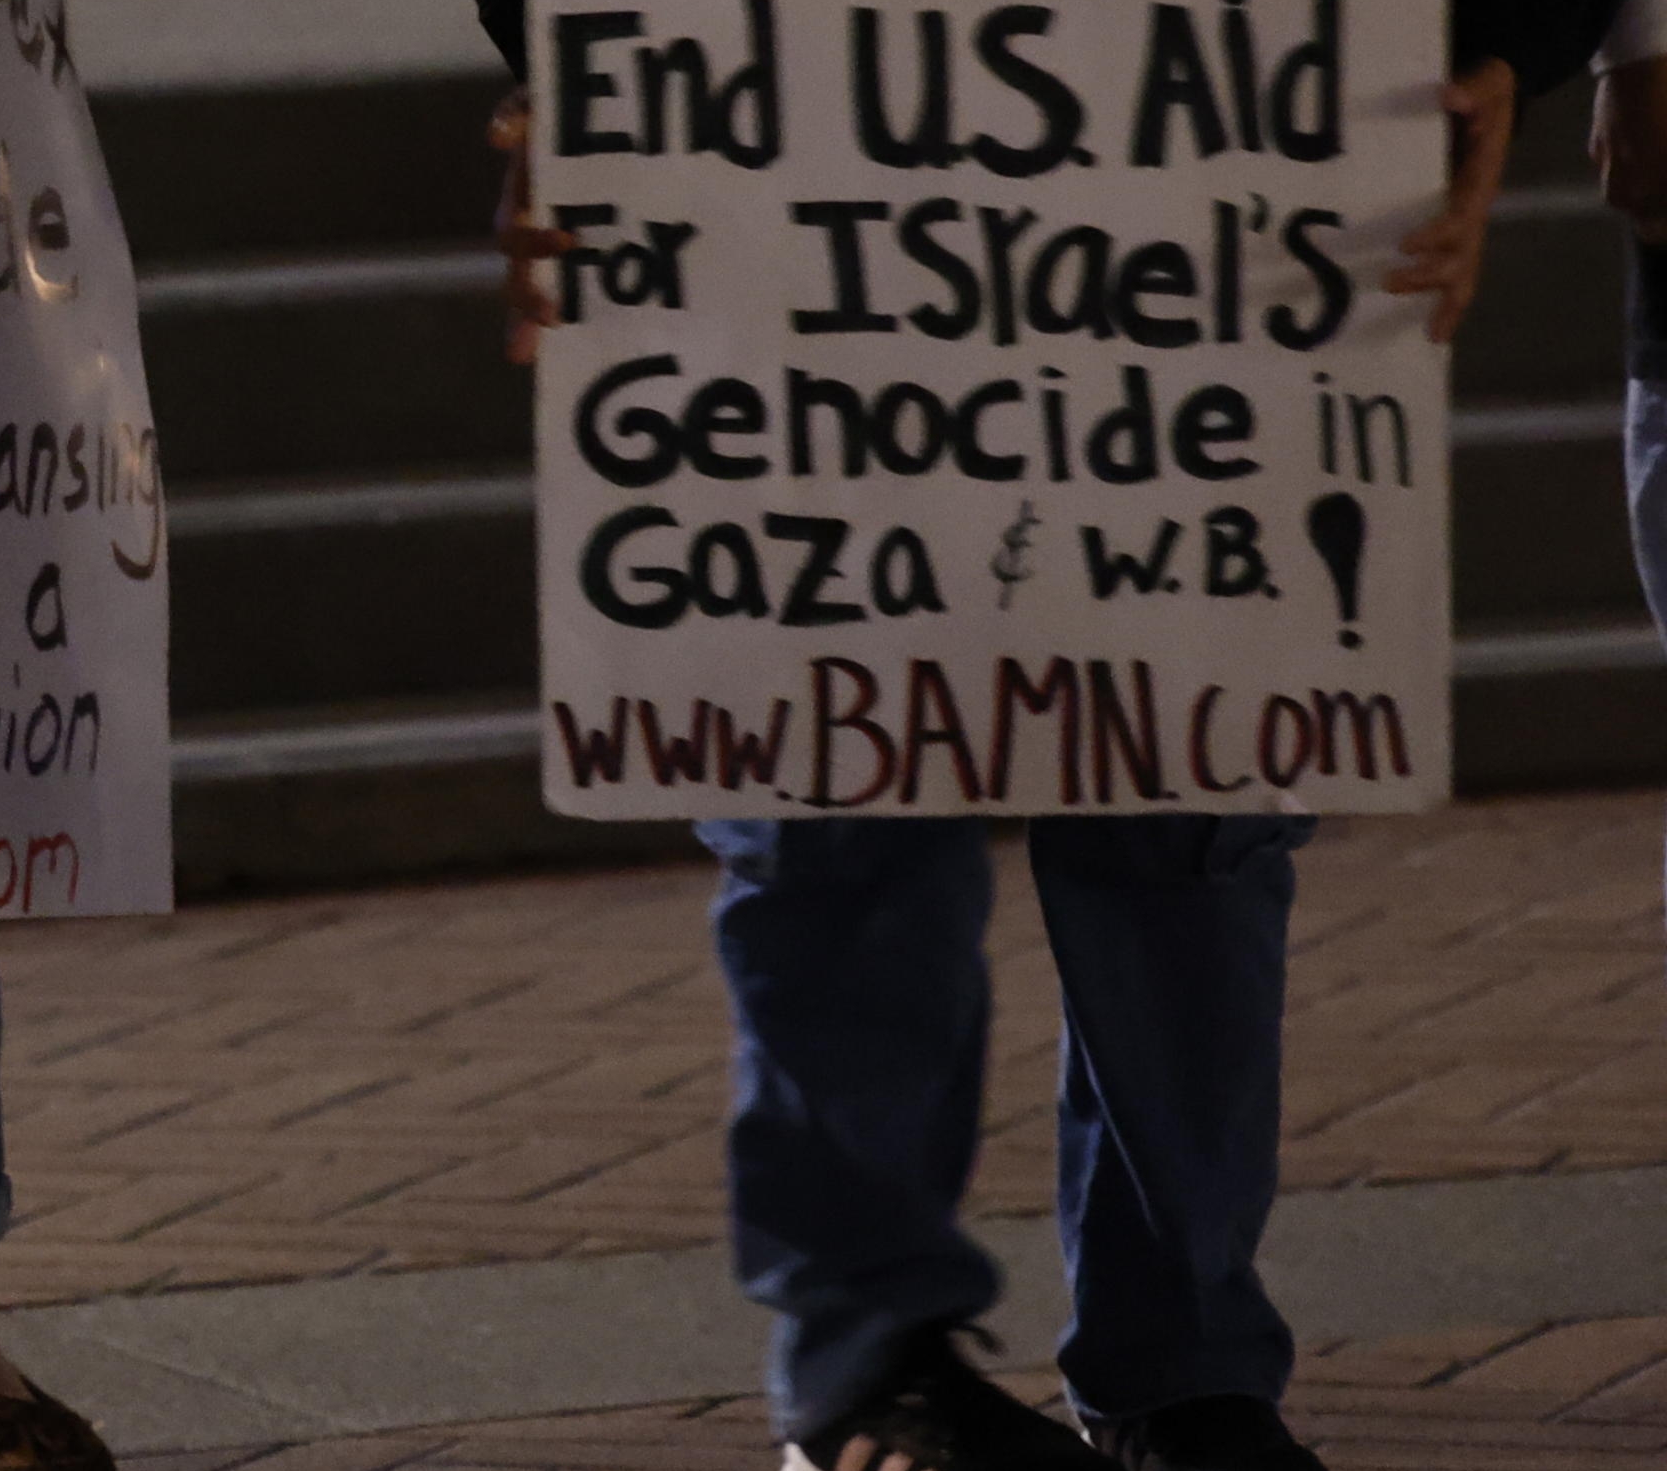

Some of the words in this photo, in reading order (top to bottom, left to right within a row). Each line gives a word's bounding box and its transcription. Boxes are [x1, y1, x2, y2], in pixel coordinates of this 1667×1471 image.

[846, 3, 1098, 178] U.S.
[552, 202, 698, 324] For
[573, 354, 1263, 489] Genocide
[1313, 371, 1415, 488] in
[25, 561, 68, 653] a
[578, 504, 947, 630] Gaza
